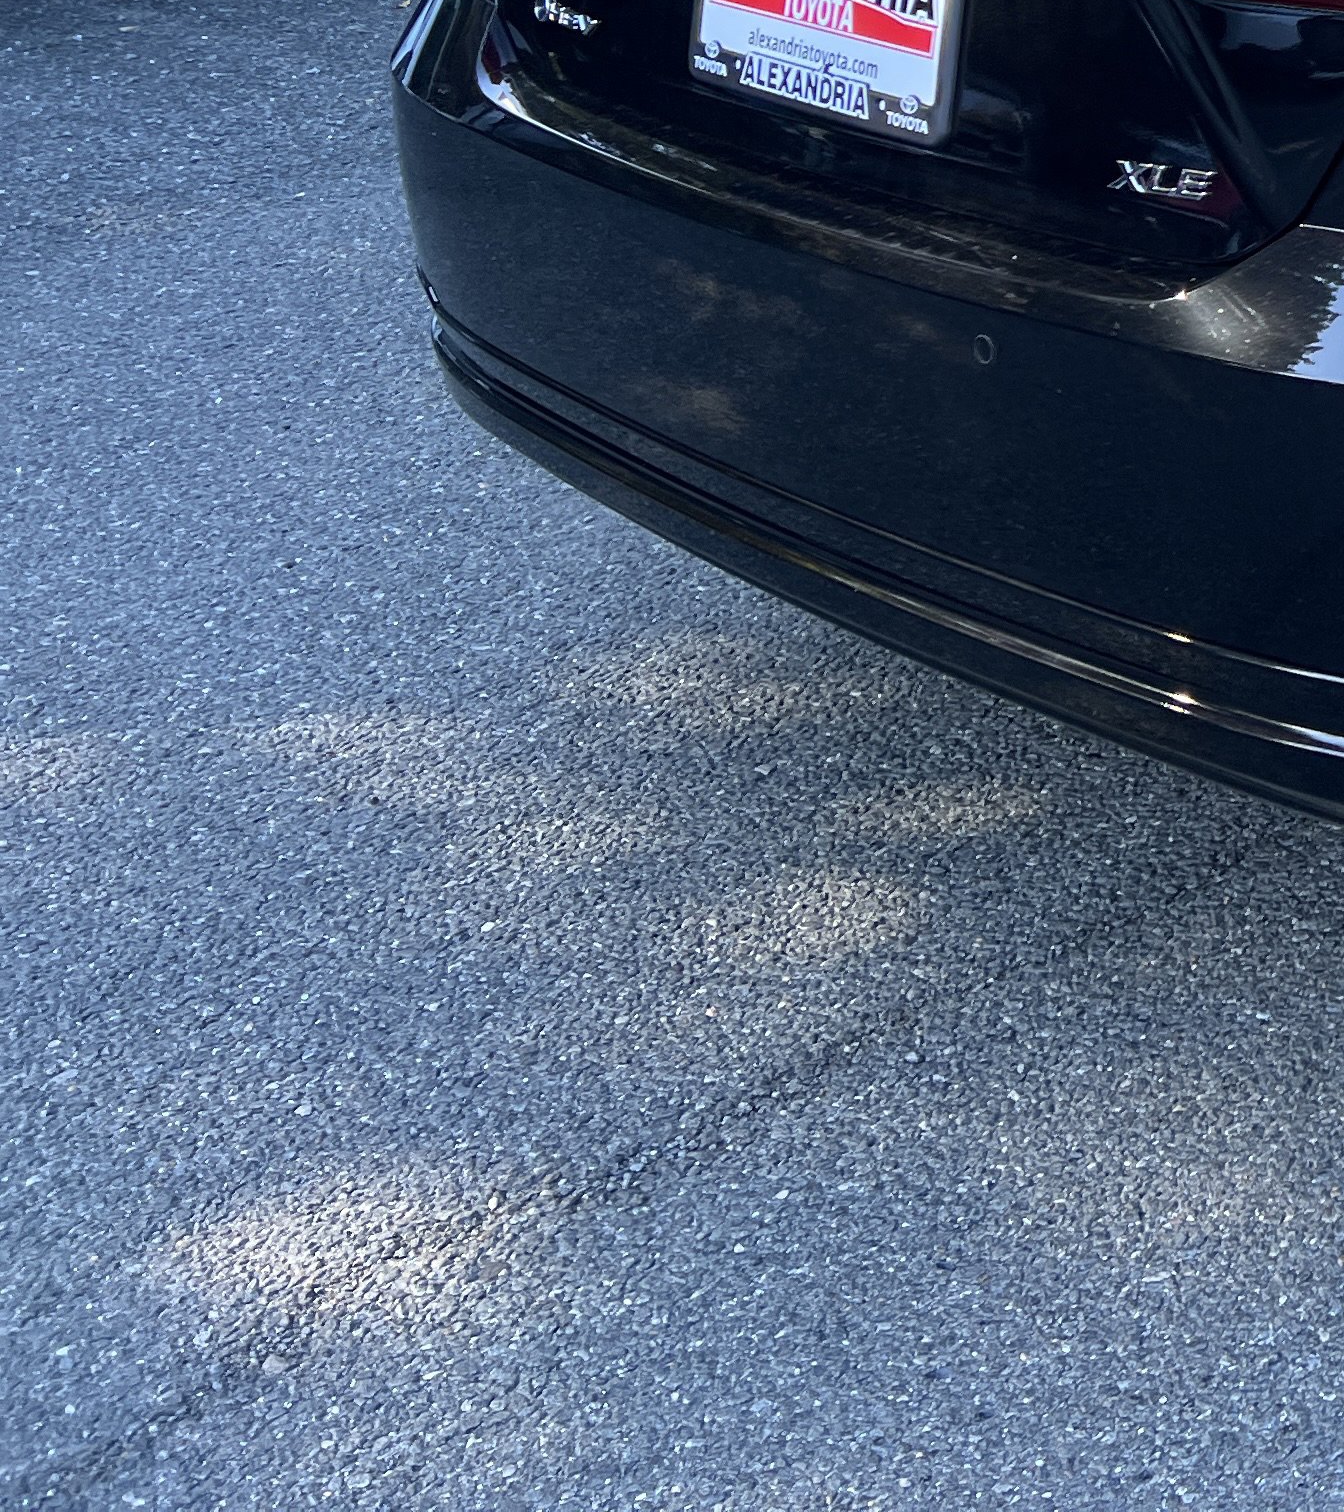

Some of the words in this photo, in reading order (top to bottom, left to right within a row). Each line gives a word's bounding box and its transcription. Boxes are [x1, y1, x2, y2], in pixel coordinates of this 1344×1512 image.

[693, 55, 727, 77] TOYOTA
[748, 28, 878, 79] alexandriatoyota.com
[740, 57, 870, 120] ALEXANDRIA
[886, 109, 929, 134] TOYOTA
[1107, 159, 1218, 200] XLE
